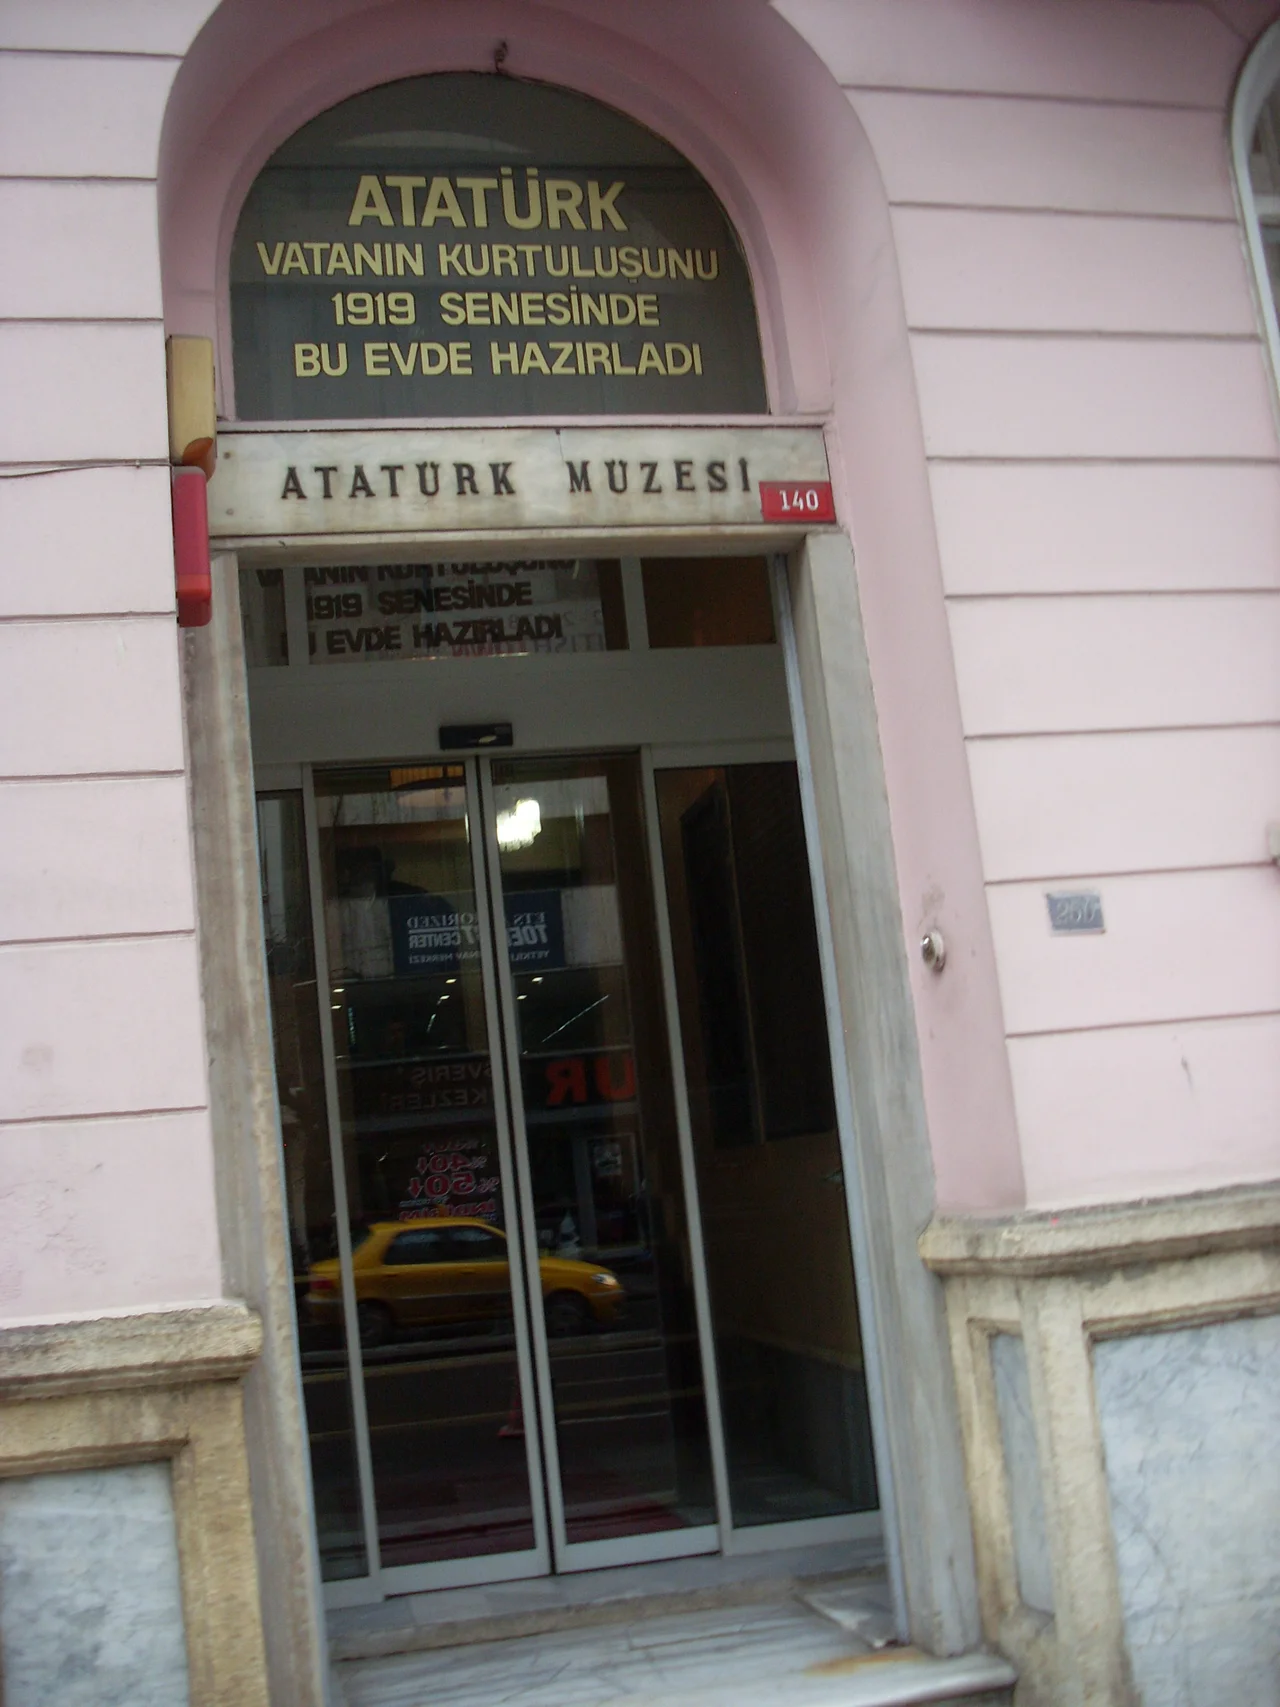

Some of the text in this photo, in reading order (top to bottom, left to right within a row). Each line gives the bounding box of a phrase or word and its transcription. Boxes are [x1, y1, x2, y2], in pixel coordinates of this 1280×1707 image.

[348, 167, 628, 231] ATATÜRK
[256, 242, 719, 283] VATANIN KURTULUŞUNU
[331, 285, 660, 326] 1919 SENESİNDE
[294, 342, 703, 377] BU EVDE HAZIRLADI
[280, 457, 751, 499] ATATÜRK MÜZESİ
[779, 490, 819, 511] 140
[377, 580, 533, 615] SENESİNDE
[326, 626, 402, 655] EVDE
[412, 613, 563, 650] HAZIRLADI
